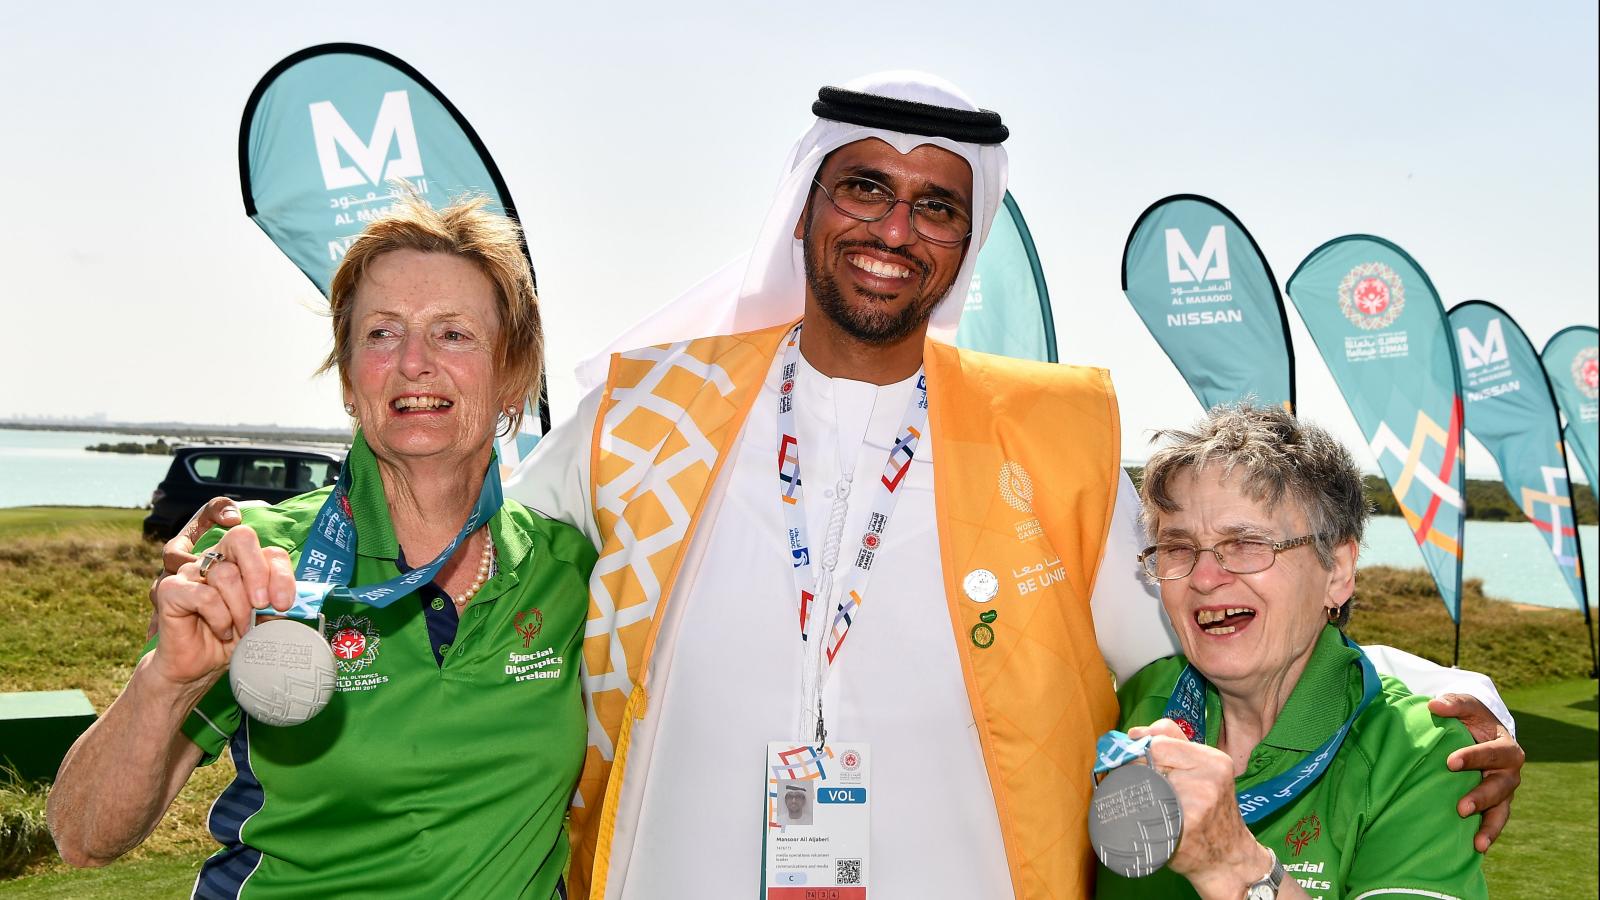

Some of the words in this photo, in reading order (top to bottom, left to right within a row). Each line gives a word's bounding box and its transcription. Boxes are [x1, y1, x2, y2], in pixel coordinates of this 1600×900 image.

[335, 213, 354, 226] AL
[1186, 294, 1232, 304] MASAOOD
[1167, 310, 1243, 327] NISSAN
[1468, 381, 1519, 402] NISSAN
[1015, 520, 1040, 532] WORLD
[1018, 527, 1042, 540] GAMES
[307, 549, 327, 568] BE
[858, 549, 867, 567] WORLD
[862, 551, 873, 569] GAMES
[1017, 579, 1037, 595] BE
[1039, 567, 1066, 587] UNIF
[509, 647, 554, 664] Special
[505, 656, 563, 675] Olympics
[354, 675, 389, 687] GAMES
[515, 668, 561, 682] Ireland
[828, 790, 856, 802] VOL
